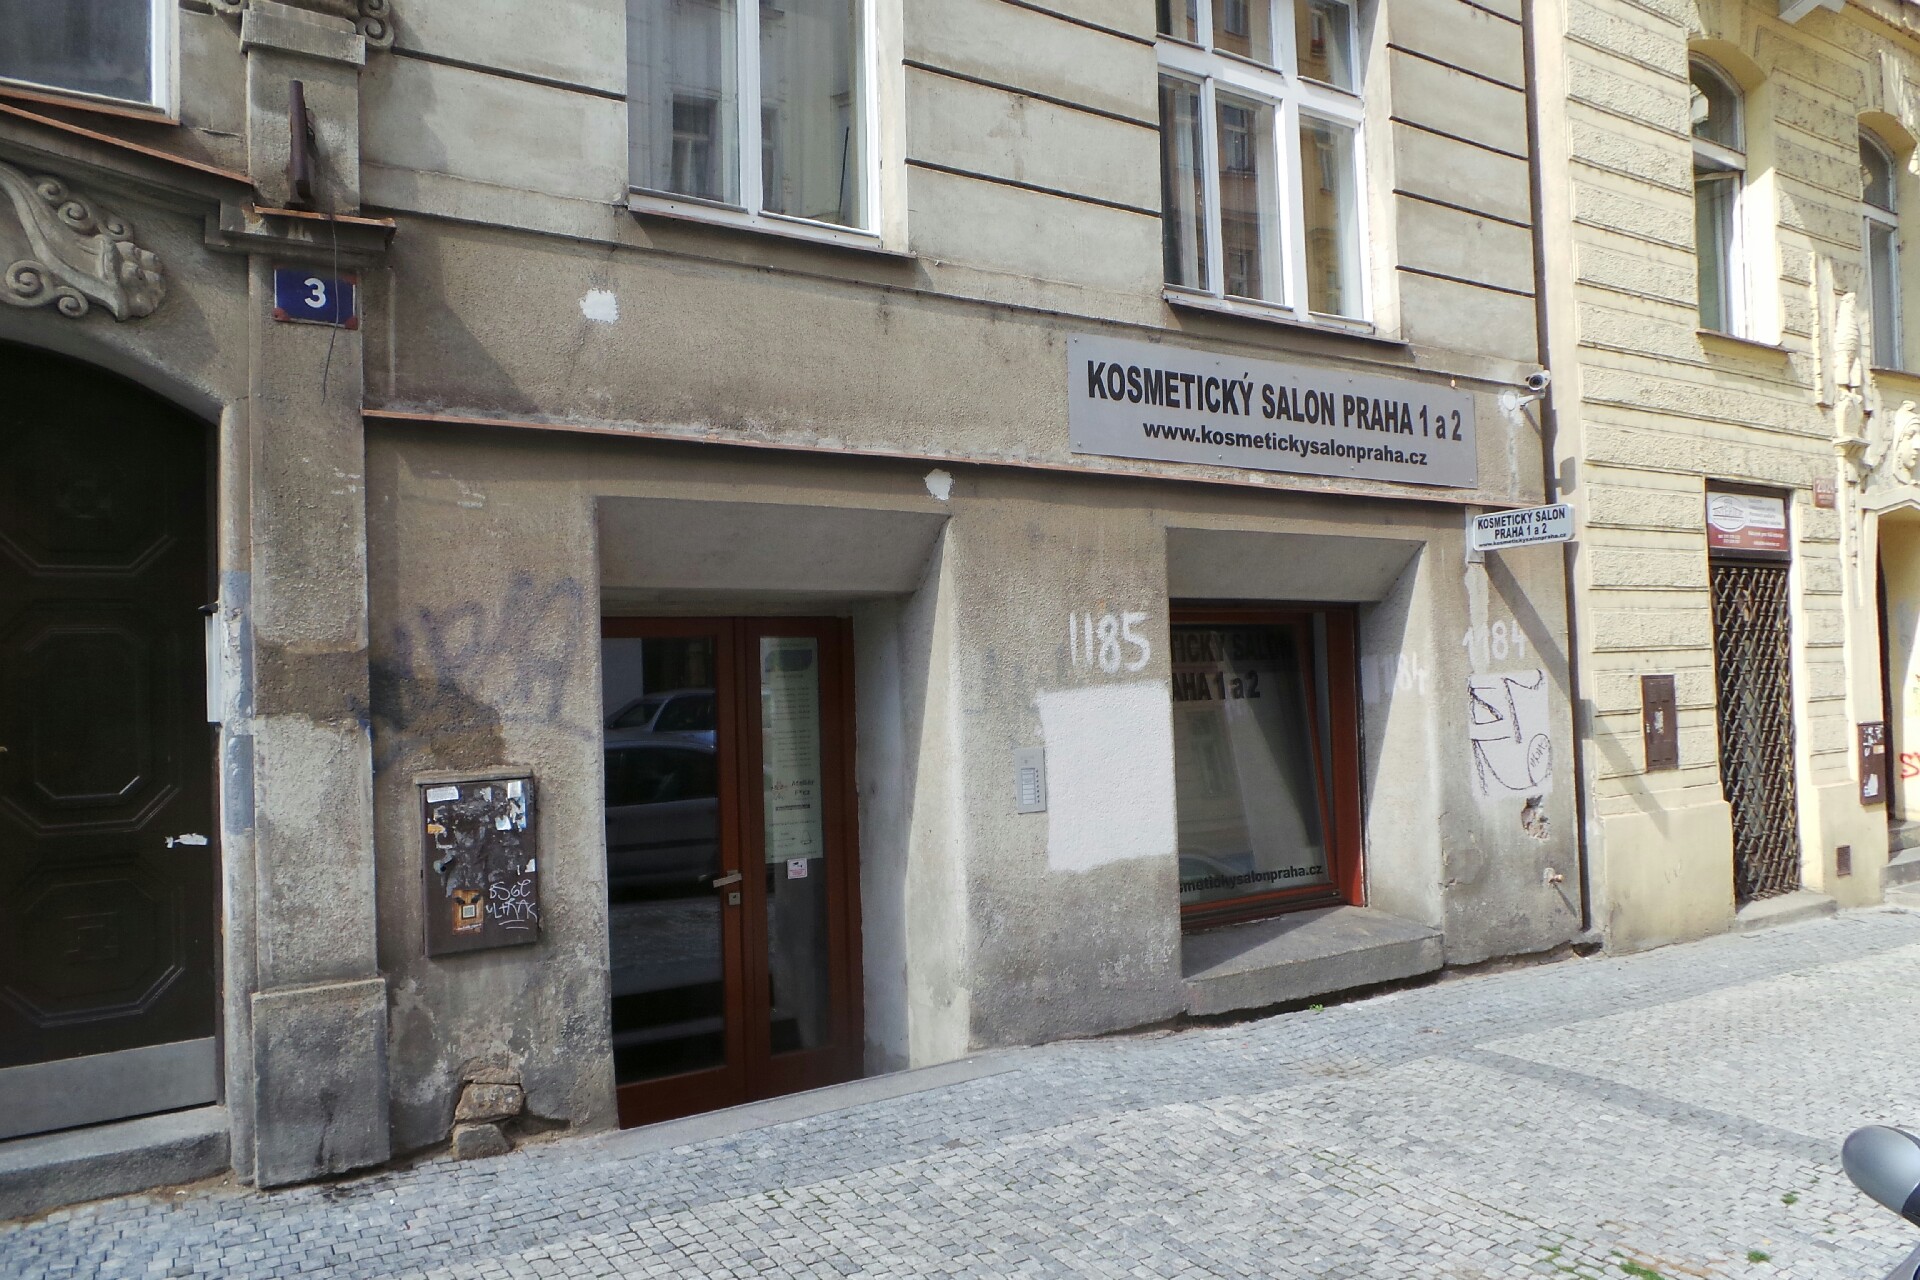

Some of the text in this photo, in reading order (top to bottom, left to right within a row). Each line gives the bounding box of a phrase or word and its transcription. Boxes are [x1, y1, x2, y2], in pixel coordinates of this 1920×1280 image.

[304, 277, 327, 309] 3
[1087, 359, 1463, 442] KOSMETICKÝ SALON PRAHA 1 a 2
[1143, 422, 1428, 466] www.kosmetickysalonpraha.cz
[1477, 507, 1566, 531] KOSMETICKÝ SALON
[1494, 522, 1547, 540] PRAHA 1 a 2
[1069, 610, 1151, 674] 1185
[1213, 671, 1226, 700] 1
[1230, 677, 1245, 699] a
[1245, 669, 1261, 698] 2
